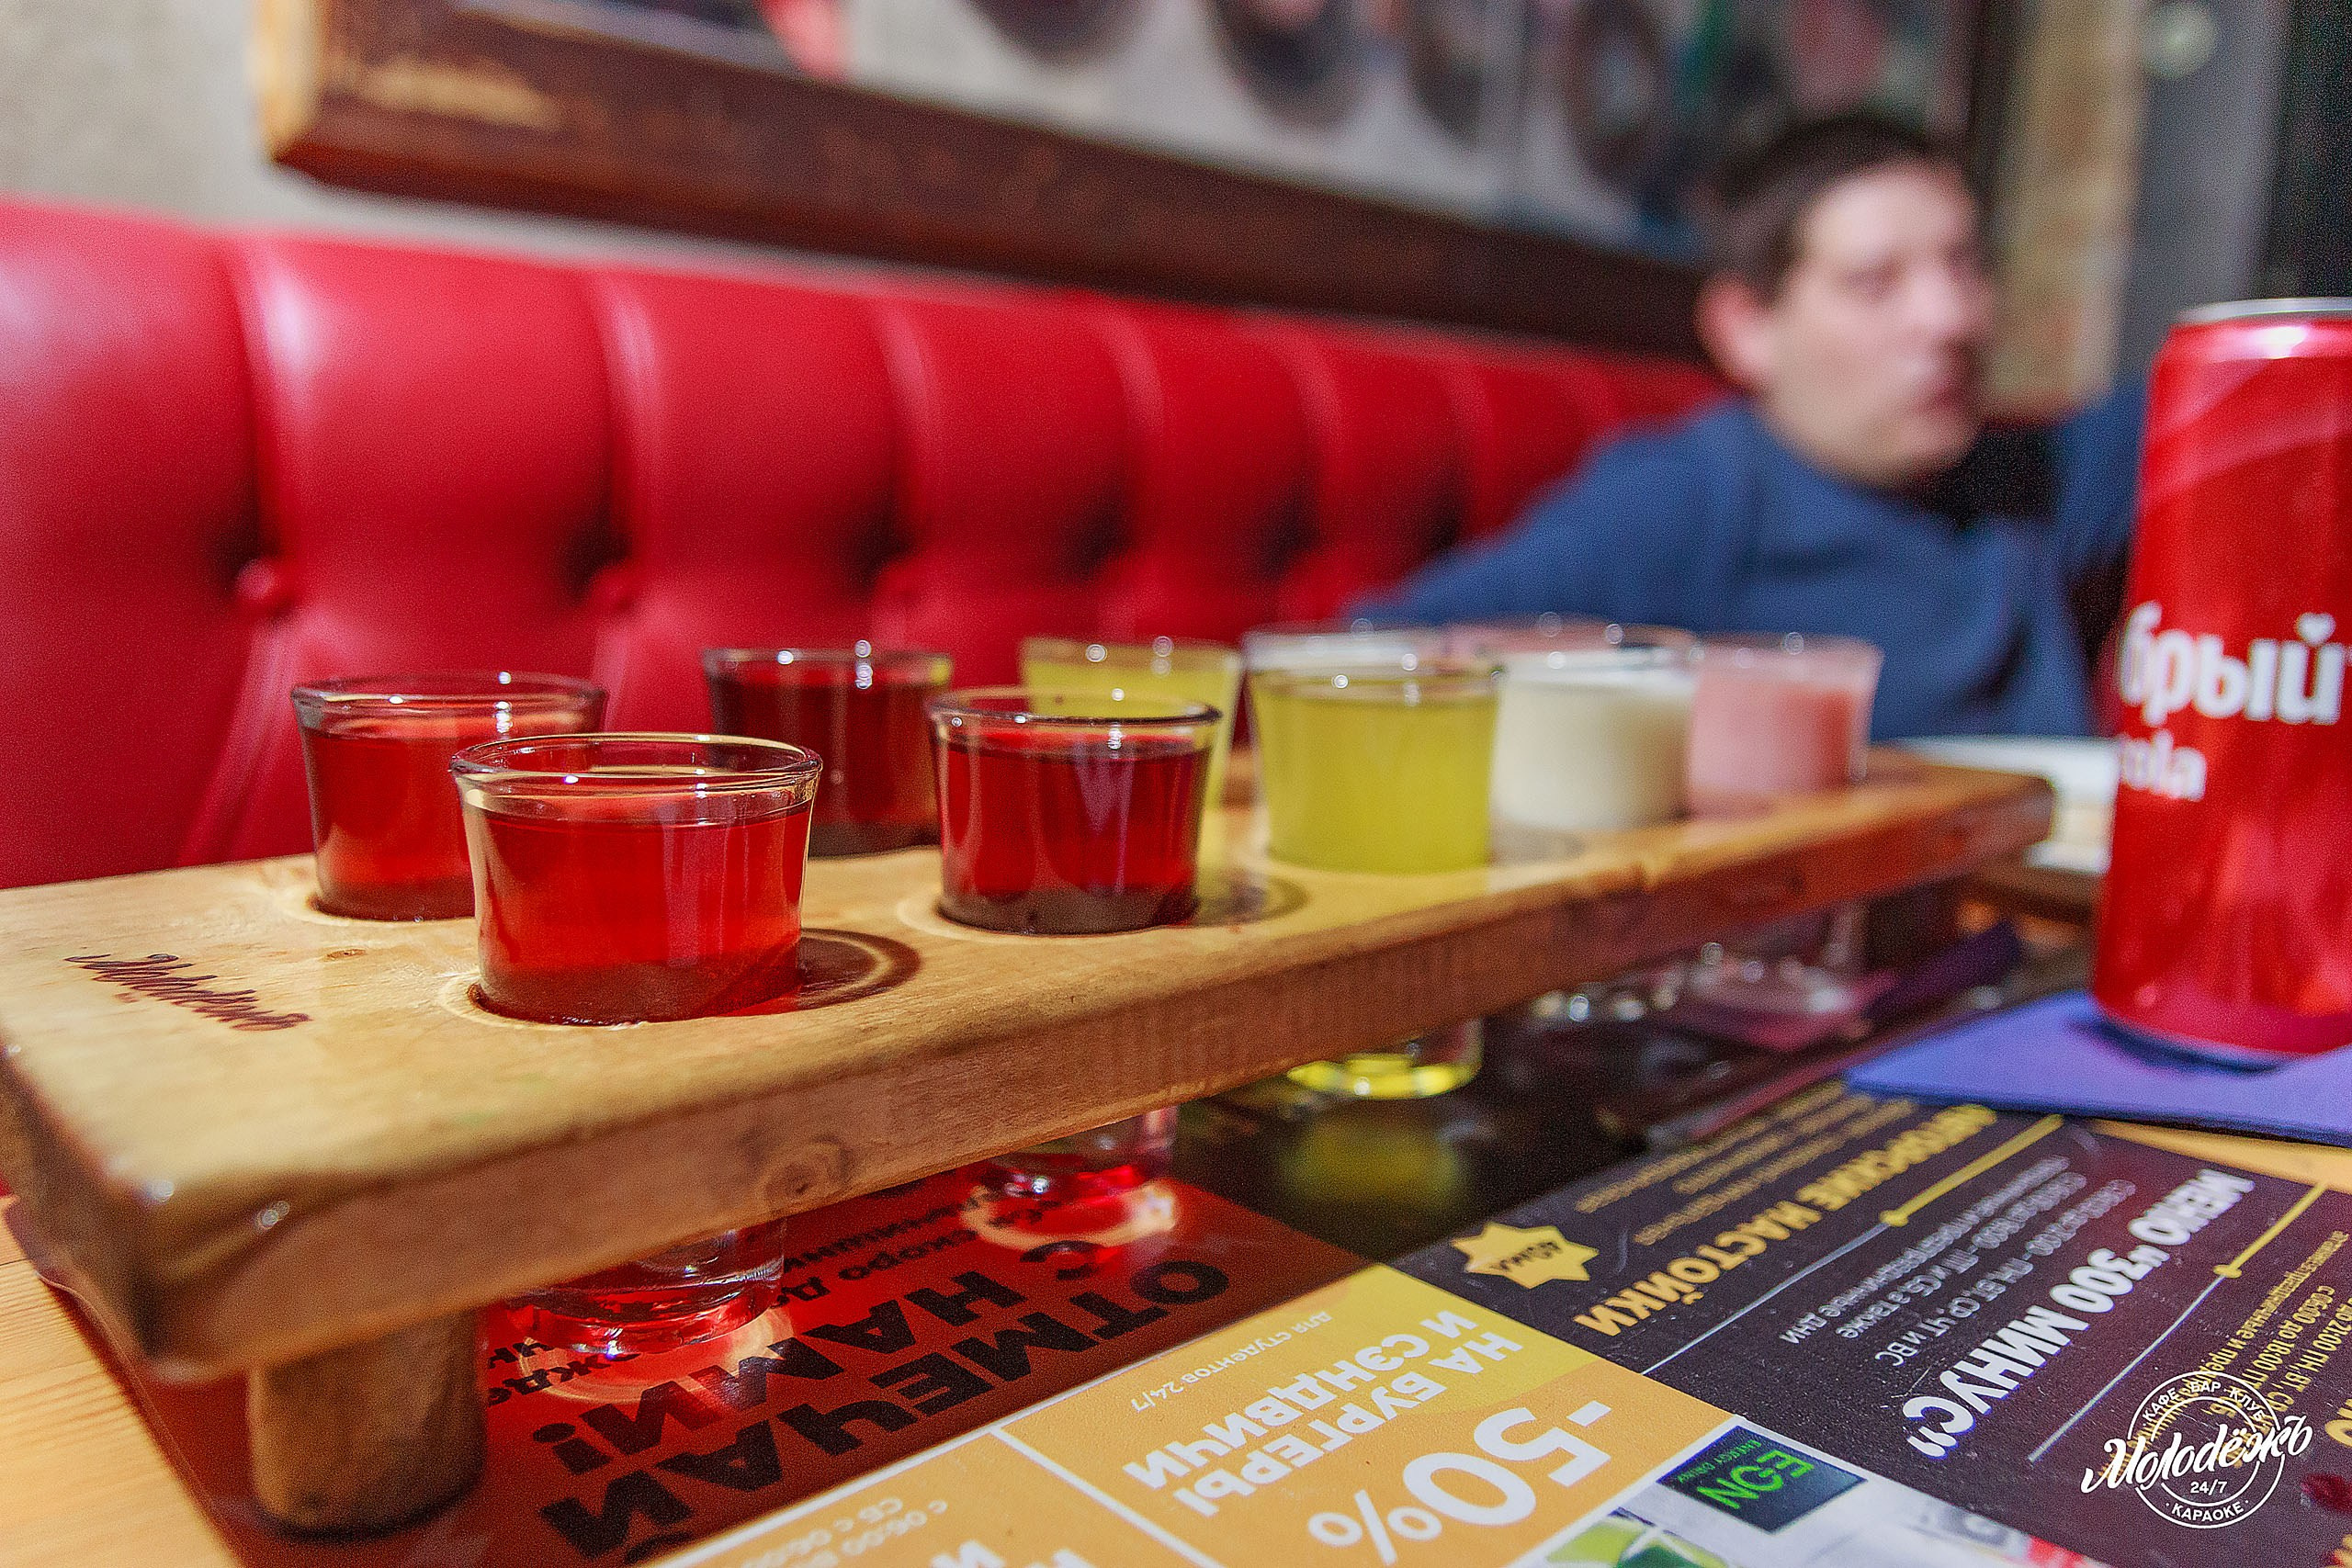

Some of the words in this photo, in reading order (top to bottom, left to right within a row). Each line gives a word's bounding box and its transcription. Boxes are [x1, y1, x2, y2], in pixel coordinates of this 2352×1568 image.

[2119, 601, 2344, 726] брый
[2123, 728, 2206, 802] ola
[2129, 1168, 2256, 1246] МЕНЮ
[1573, 1201, 1821, 1336] НАСТОЙКИ
[2317, 1286, 2335, 1295] с
[1292, 1311, 1332, 1336] для
[1420, 1309, 1479, 1338] И
[1779, 1313, 1827, 1343] дни
[1837, 1300, 1900, 1338] также
[1917, 1317, 1956, 1337] ЧТ
[2278, 1320, 2303, 1339] до
[2312, 1319, 2352, 1351] 21:00
[1429, 1331, 1523, 1375] НА
[1875, 1341, 1918, 1366] ВС
[1903, 1331, 1928, 1344] и
[2227, 1338, 2246, 1349] и
[1182, 1331, 1293, 1386] студентов
[2253, 1339, 2294, 1371] 18:00
[2288, 1349, 2330, 1372] ПН,
[532, 1270, 1028, 1474] НАМИ!
[2271, 1372, 2311, 1392] ВТ,
[542, 1260, 1229, 1566] ОТМЕЧАЙ
[1122, 1332, 1430, 1490] СЭНДВИЧИ
[1132, 1381, 1184, 1413] 24/7
[1173, 1371, 1447, 1517] БУРГЕРЫ
[1308, 1400, 1611, 1565] -50%
